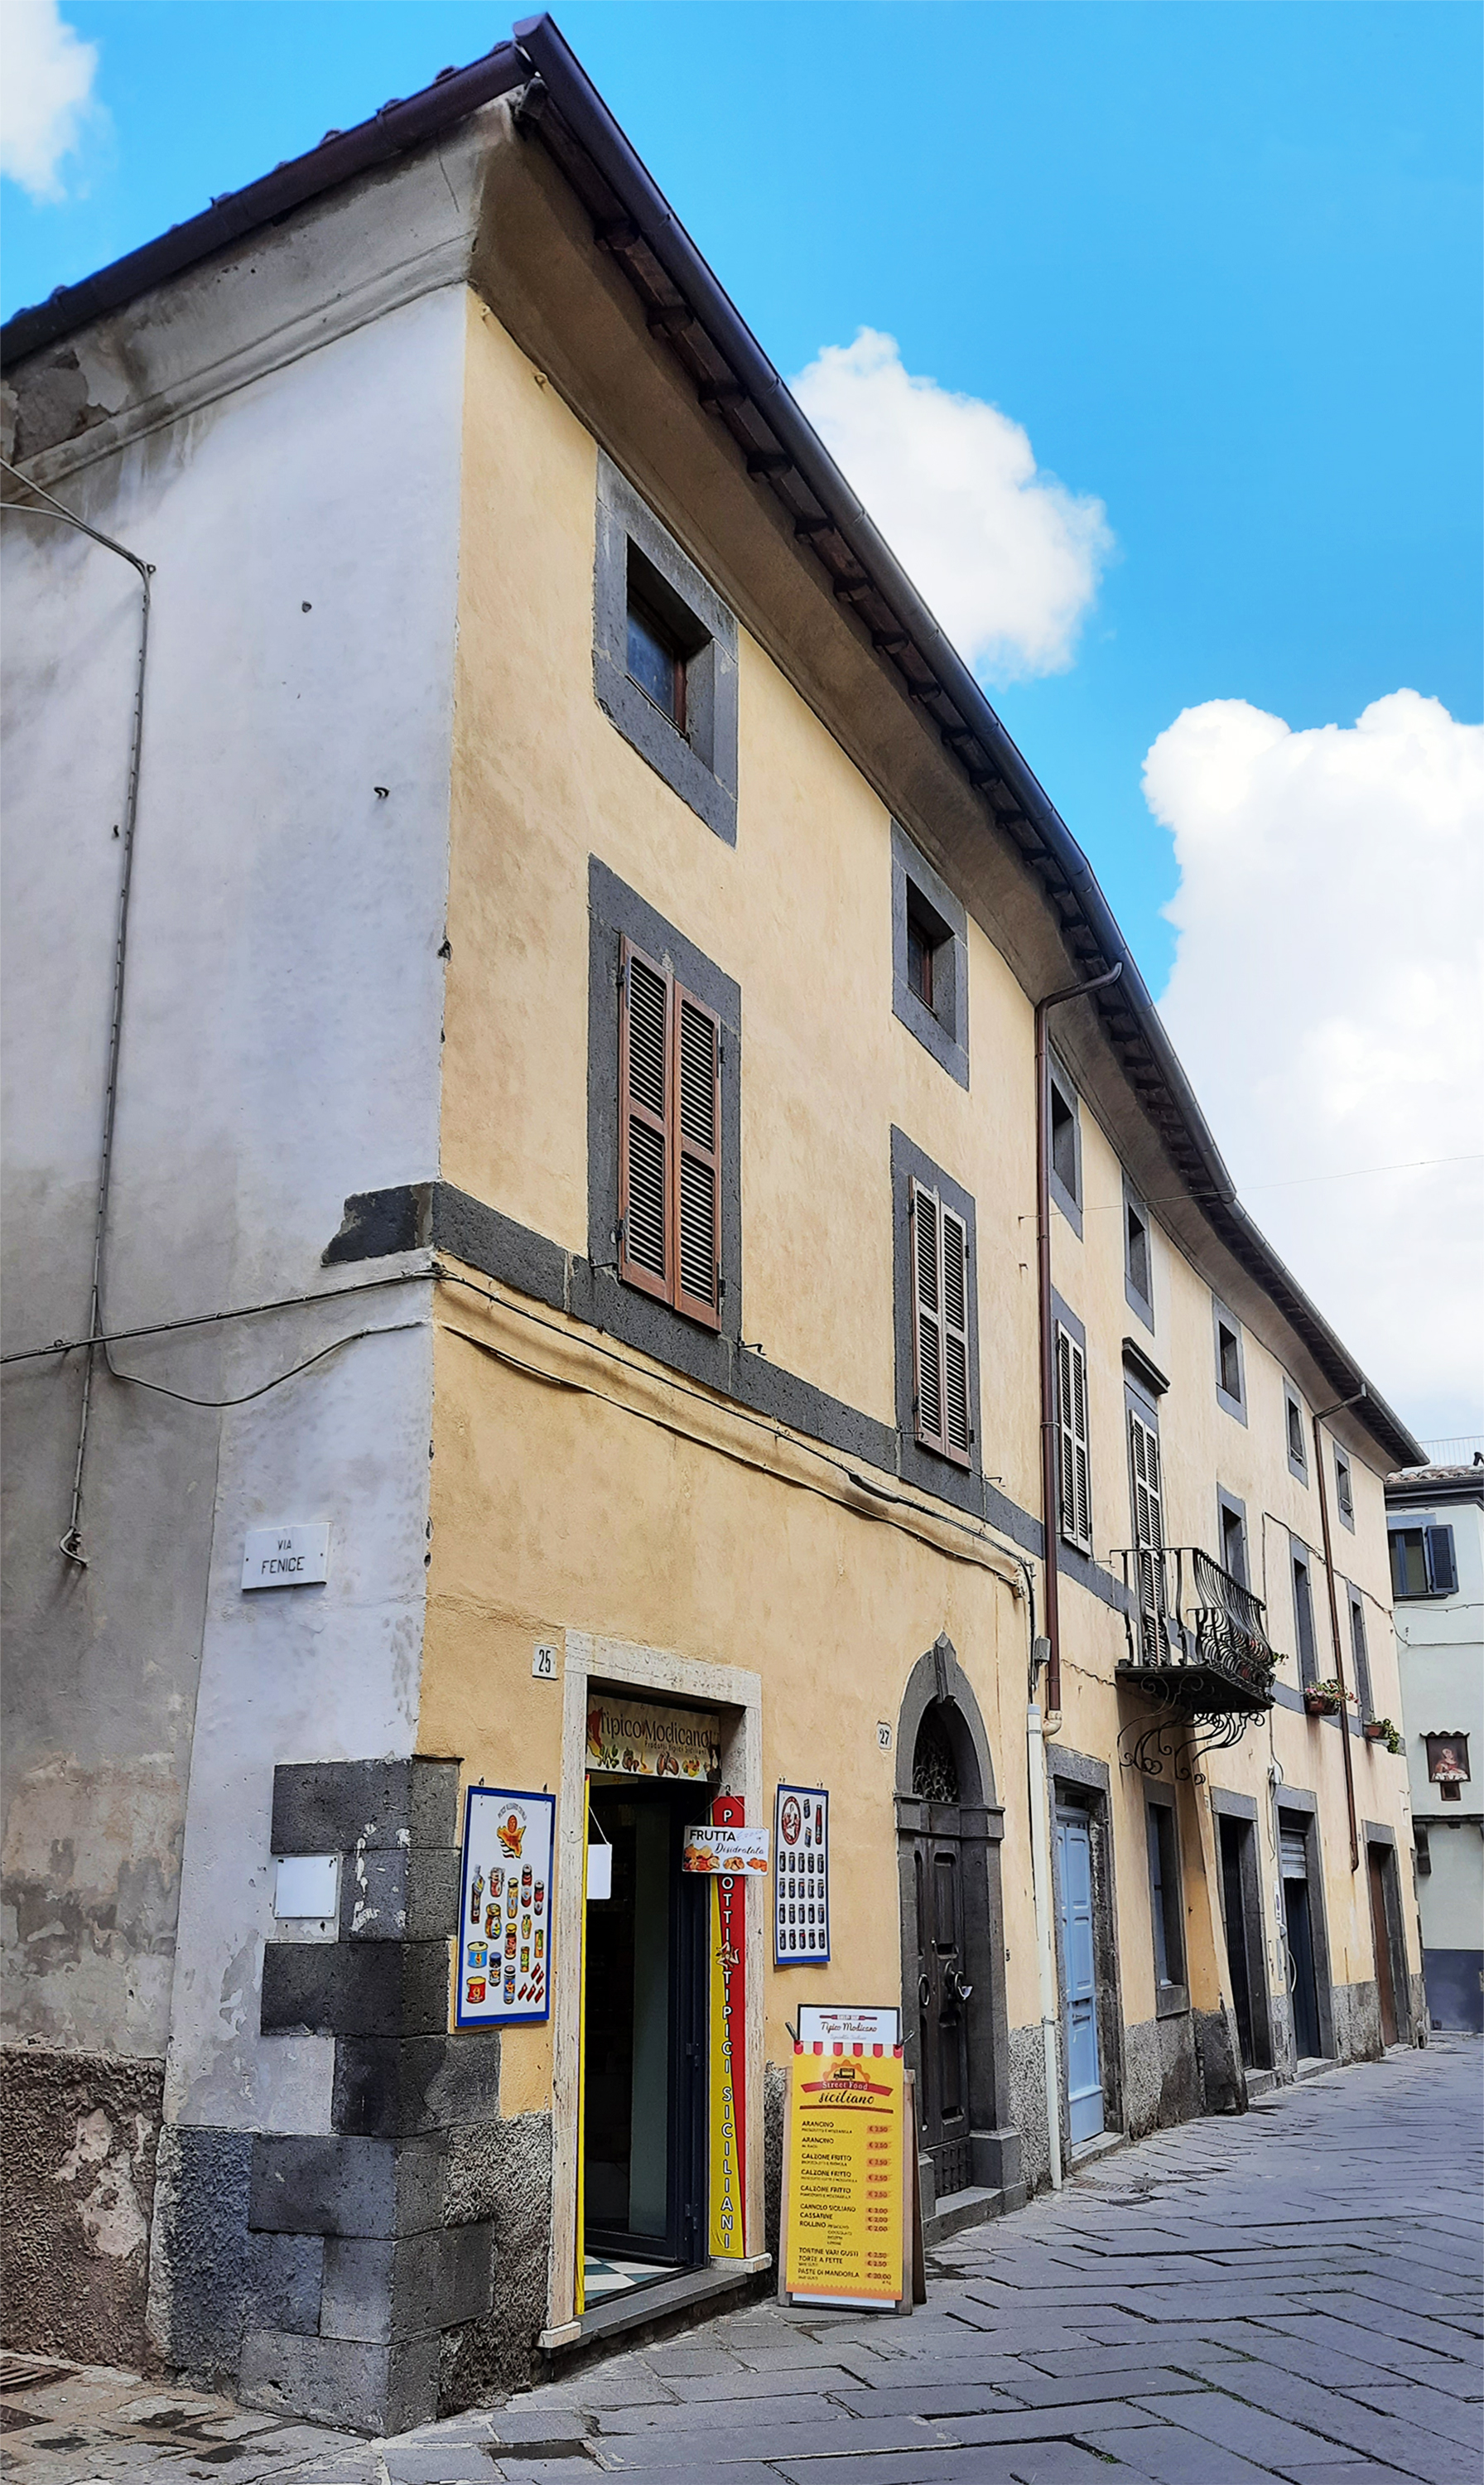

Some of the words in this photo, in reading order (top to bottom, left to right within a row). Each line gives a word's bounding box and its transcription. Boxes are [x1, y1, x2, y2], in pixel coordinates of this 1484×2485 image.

[277, 1540, 292, 1550] VIA
[261, 1556, 305, 1574] FENICE
[539, 1649, 551, 1673] 25
[600, 1707, 642, 1740] Tipico
[644, 1719, 709, 1748] Modicano
[879, 1728, 889, 1745] 27
[690, 1830, 735, 1841] FRUTTA
[722, 1971, 733, 2072] TIPICI
[821, 2022, 841, 2034] Tipico
[843, 2023, 878, 2032] Modicano
[849, 2081, 868, 2090] Food
[818, 2090, 874, 2104] siciliano
[720, 2087, 733, 2249] SICILIANI
[800, 2212, 833, 2220] CASSATINE
[824, 2270, 860, 2278] MANDORLA
